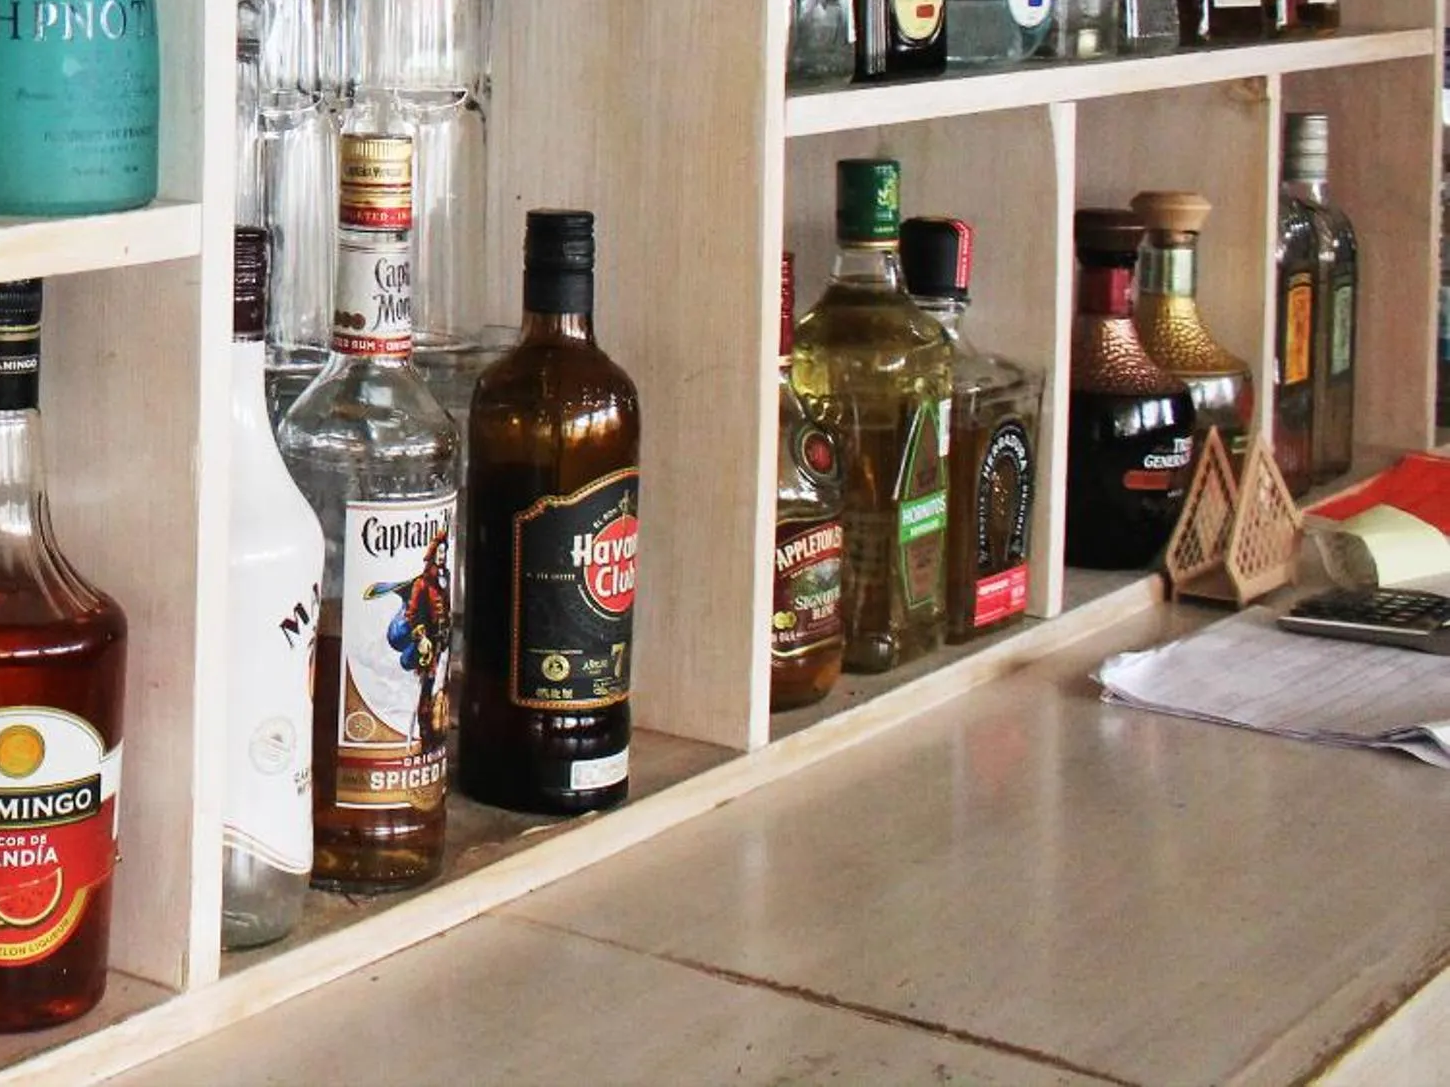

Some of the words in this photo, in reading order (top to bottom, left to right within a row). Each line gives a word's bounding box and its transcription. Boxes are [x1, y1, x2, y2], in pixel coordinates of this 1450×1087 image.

[361, 515, 438, 558] Captain
[369, 762, 440, 791] SPICED
[30, 833, 48, 846] DE
